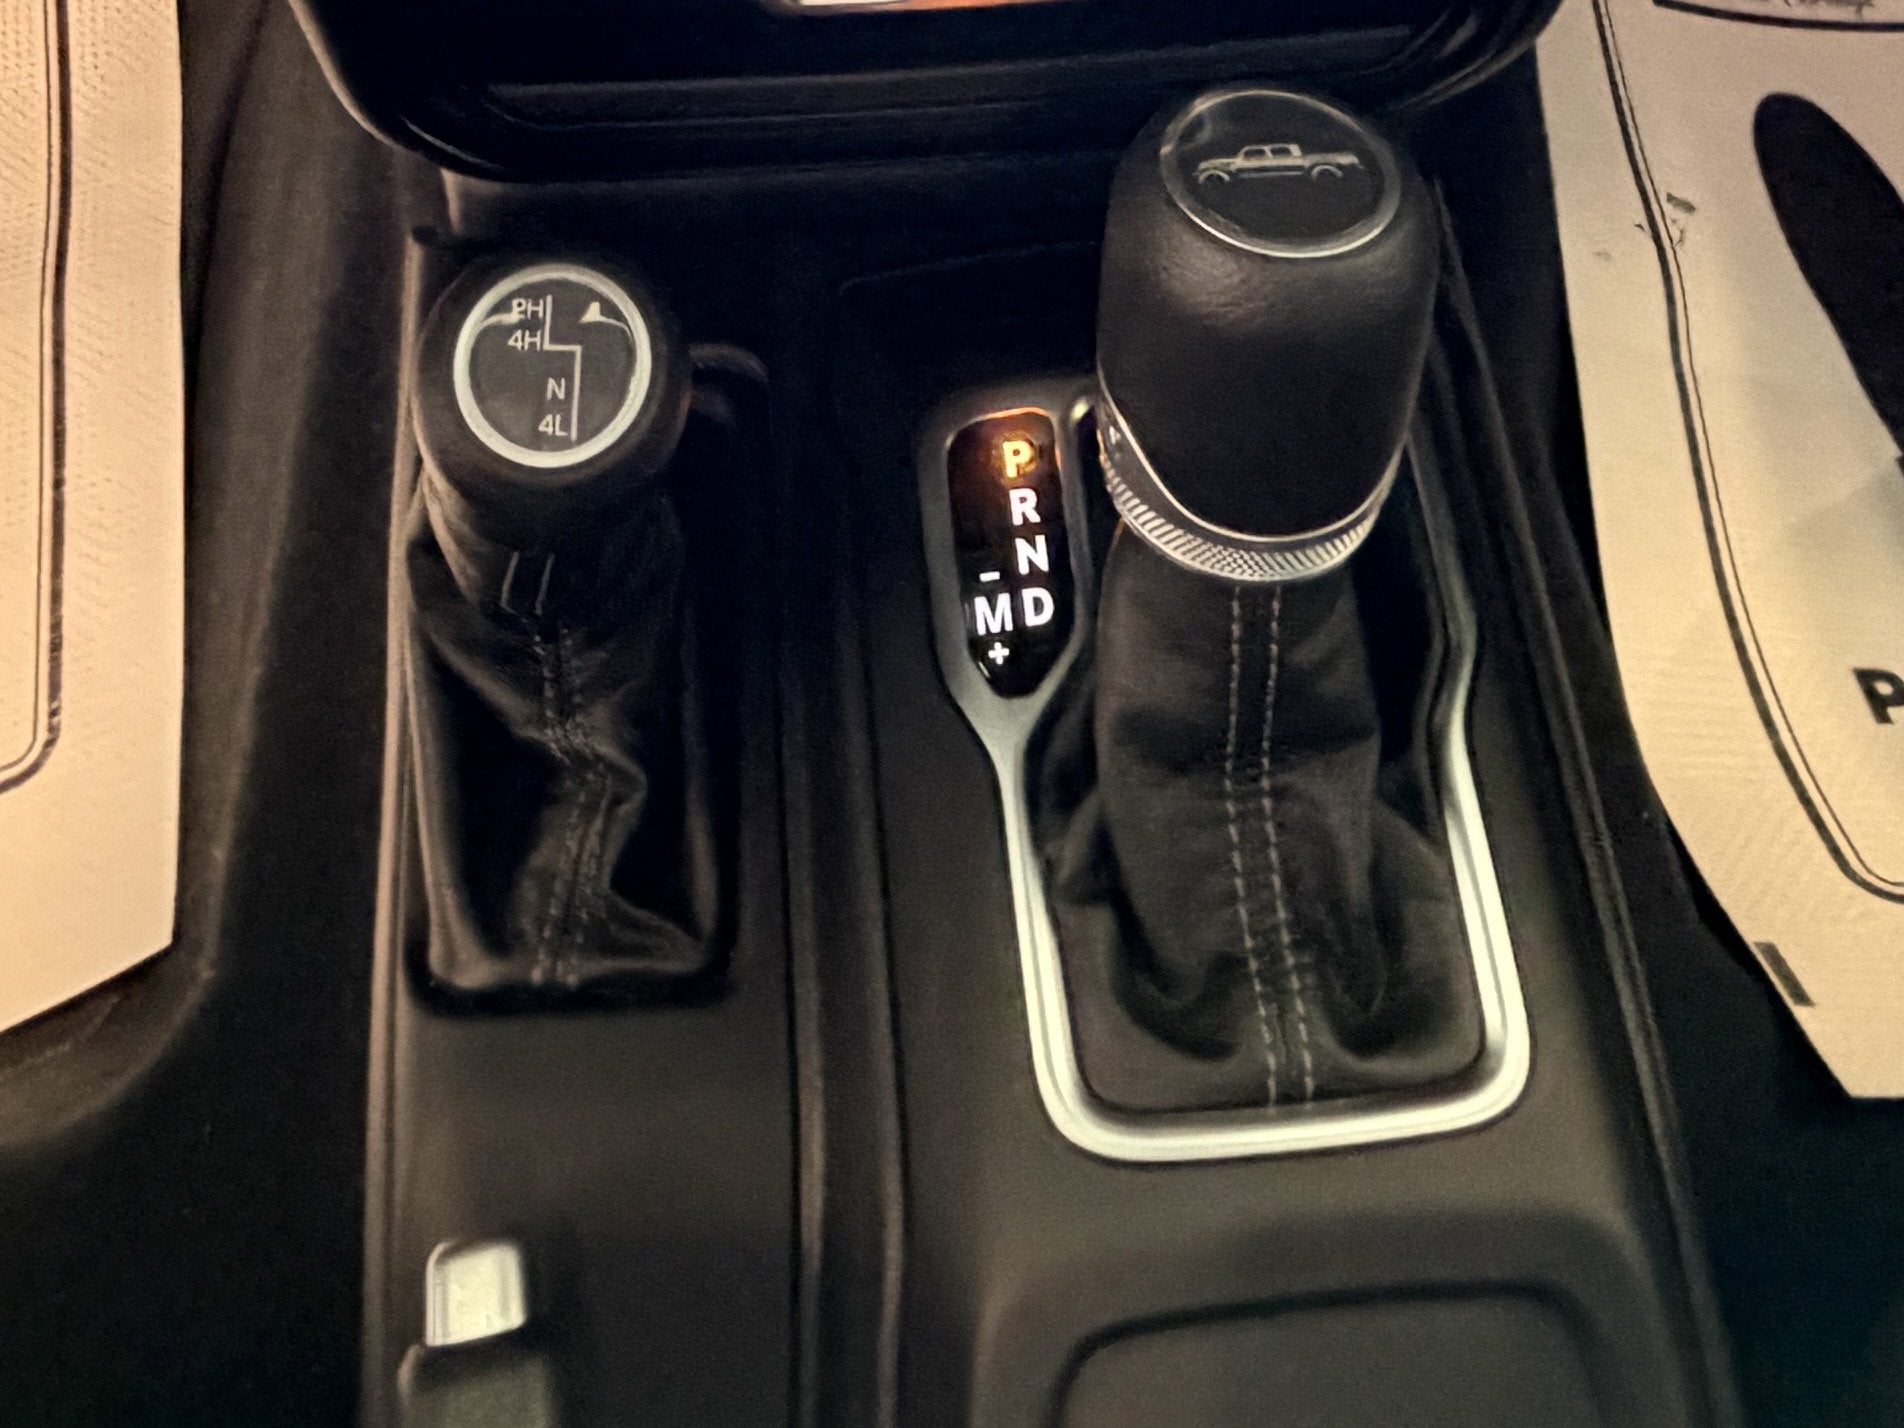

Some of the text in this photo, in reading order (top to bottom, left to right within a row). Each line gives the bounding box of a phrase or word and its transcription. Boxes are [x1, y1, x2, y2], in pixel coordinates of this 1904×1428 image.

[507, 330, 542, 351] 4H
[547, 378, 566, 400] N
[538, 414, 568, 436] 4L
[1002, 440, 1033, 478] P
[1009, 488, 1041, 526] R
[1015, 534, 1049, 575] N
[974, 587, 1055, 636] M D
